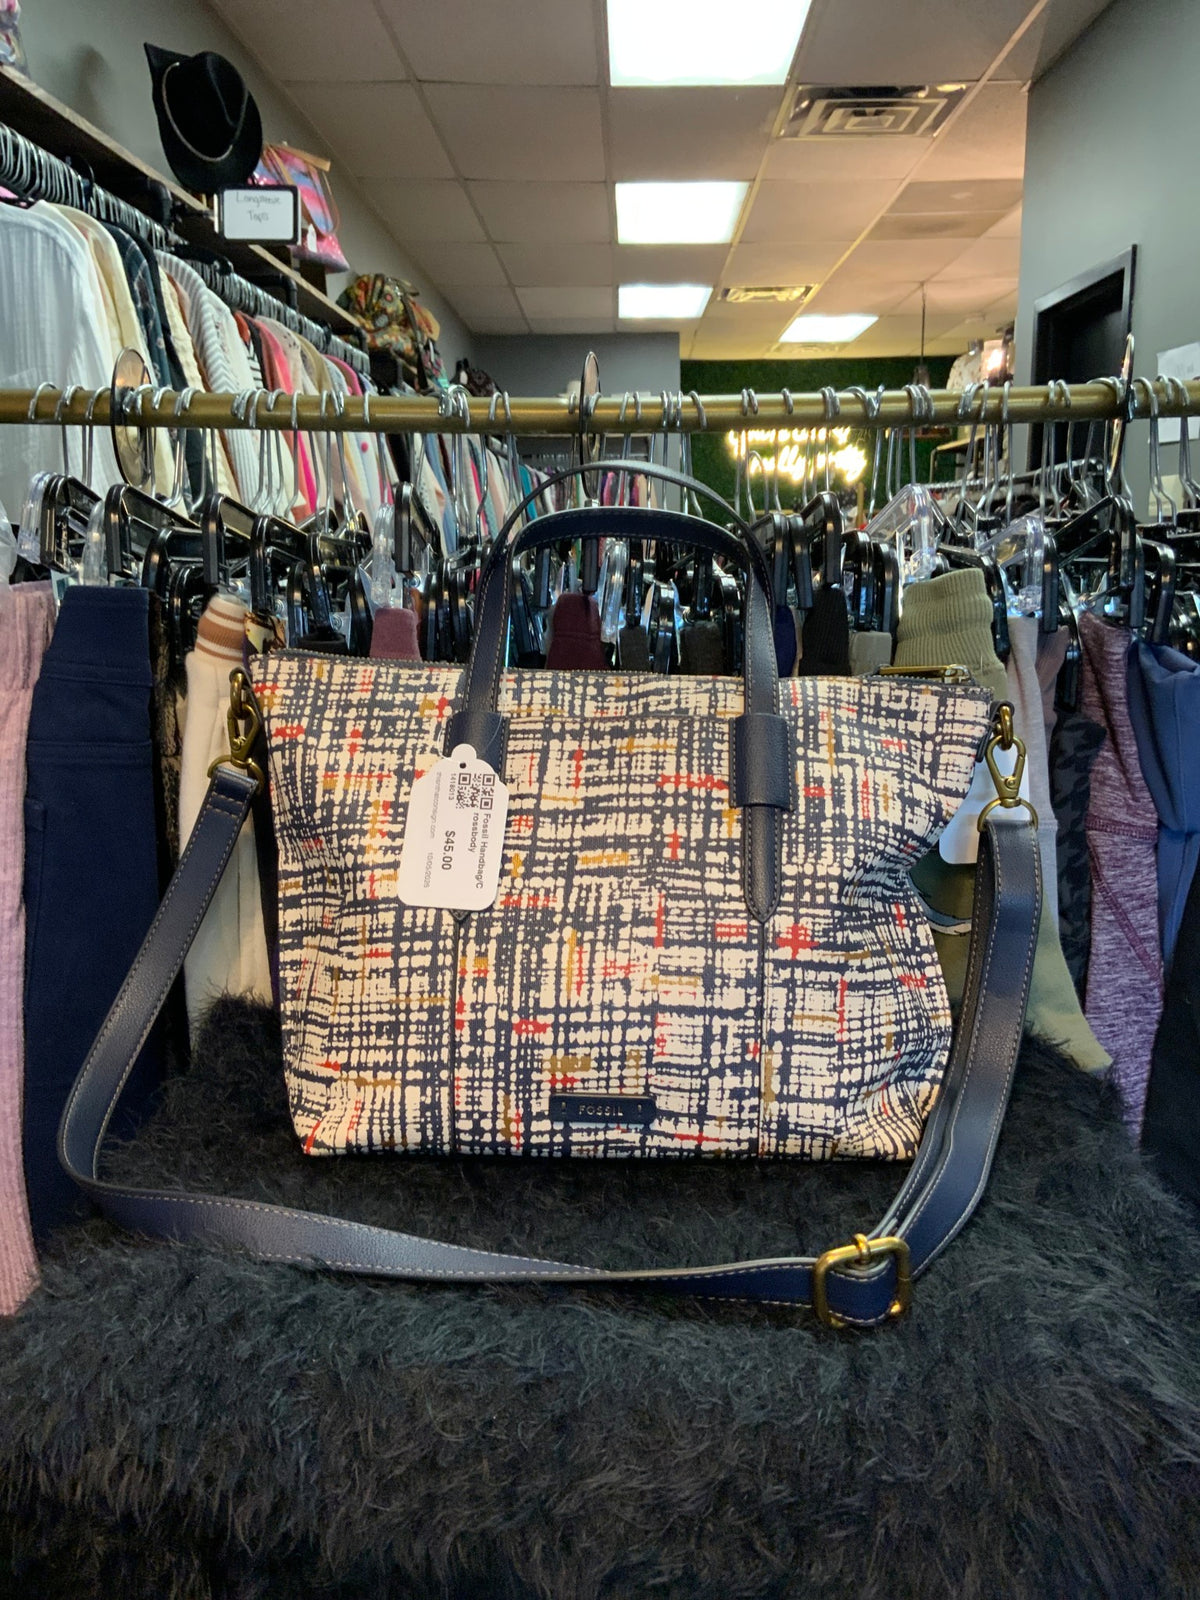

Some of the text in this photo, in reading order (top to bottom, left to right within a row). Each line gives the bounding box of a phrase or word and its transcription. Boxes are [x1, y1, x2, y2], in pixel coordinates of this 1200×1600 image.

[441, 830, 456, 871] $45.00
[468, 812, 479, 853] rossbody
[476, 813, 491, 889] Fossil Handbag/C
[578, 1104, 624, 1117] FOSSIL
